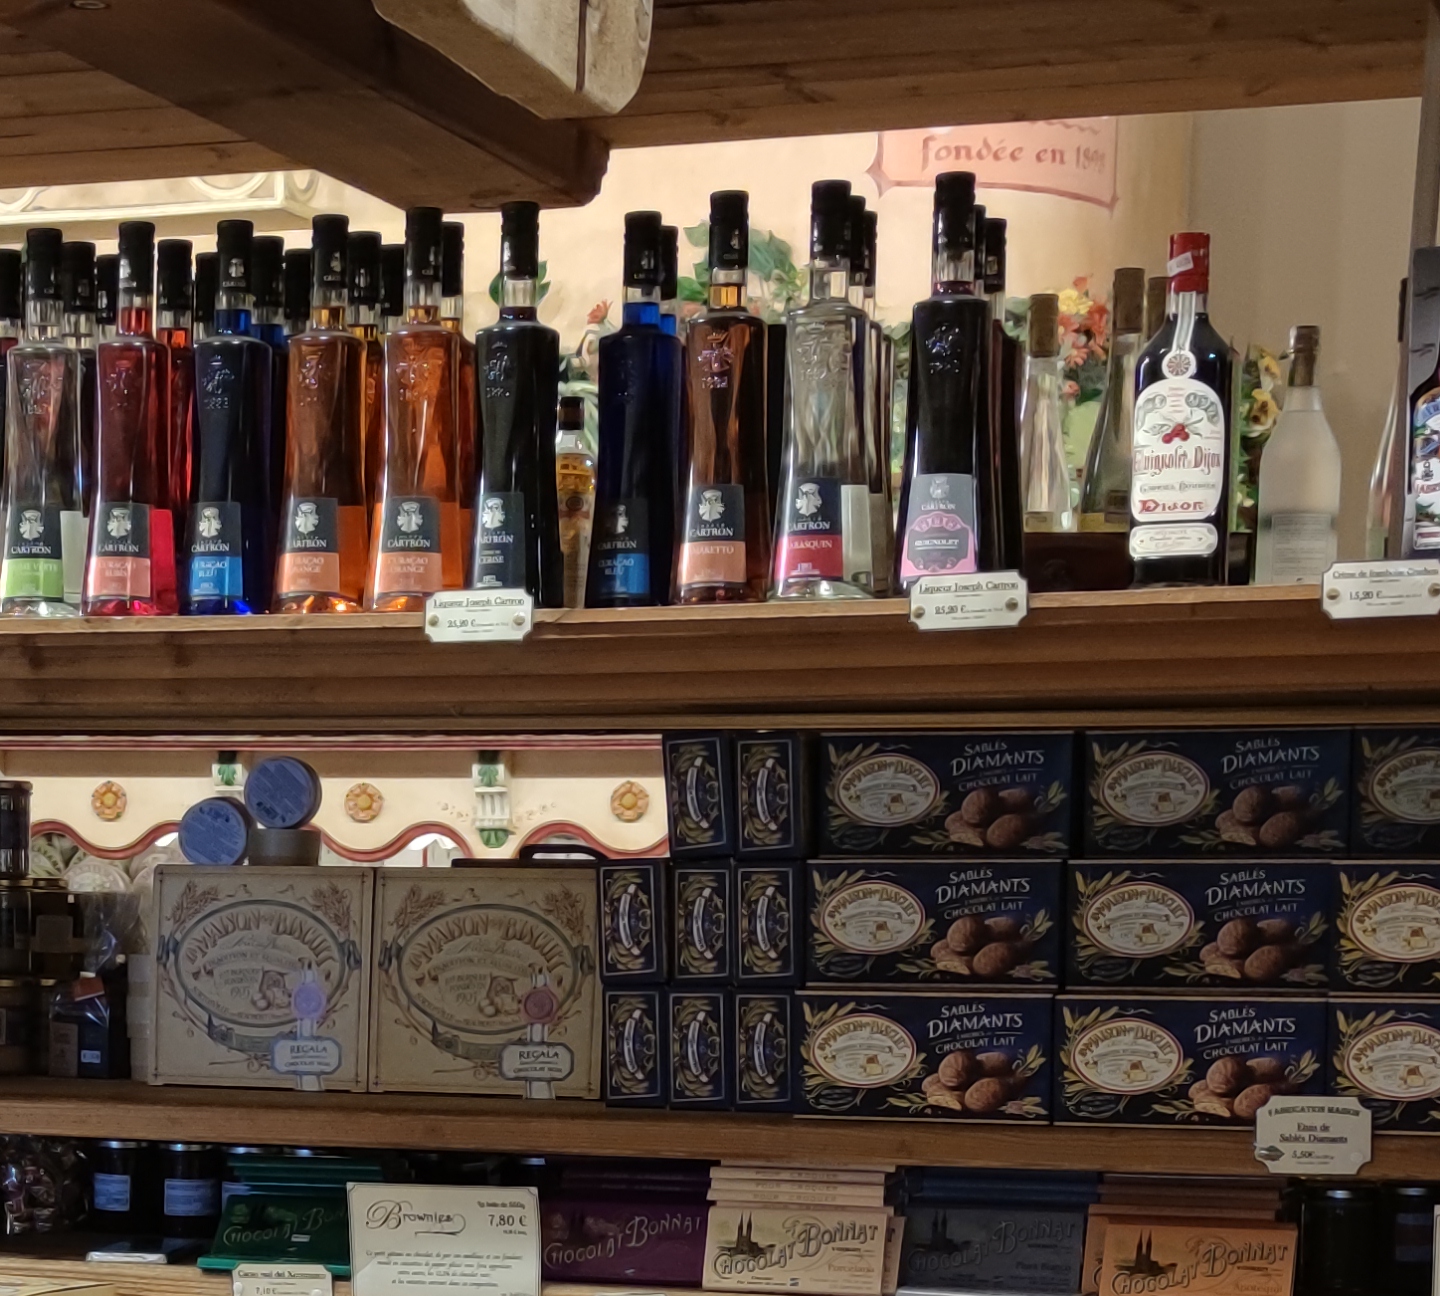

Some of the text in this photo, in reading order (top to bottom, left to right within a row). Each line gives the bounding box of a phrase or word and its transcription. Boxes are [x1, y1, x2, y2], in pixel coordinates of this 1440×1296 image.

[1035, 148, 1067, 166] en
[949, 750, 1045, 776] DIAMANTS
[1221, 745, 1321, 774] DIAMANTS
[948, 868, 994, 884] SABLÉS
[1219, 868, 1267, 885] SABLÉS
[934, 877, 1032, 905] DIAMANTS
[1205, 878, 1307, 906] DIAMANTS
[943, 900, 1024, 921] CHOCOLAT LAIT
[1213, 901, 1299, 923] CHOCOLAT LAIT
[926, 1012, 1024, 1039] DIAMANTS
[1194, 1016, 1297, 1045] DIAMANTS
[934, 1034, 1017, 1055] CHOCOLAT LAIT
[1202, 1040, 1289, 1060] CHOCOLAT LAIT
[488, 1214, 528, 1228] 7,80 €
[543, 1233, 623, 1270] CHOCOLAT
[625, 1213, 703, 1248] BONNAT
[712, 1214, 879, 1280] CHOCOLAT BONNAT
[1200, 1241, 1289, 1278] BONNAT
